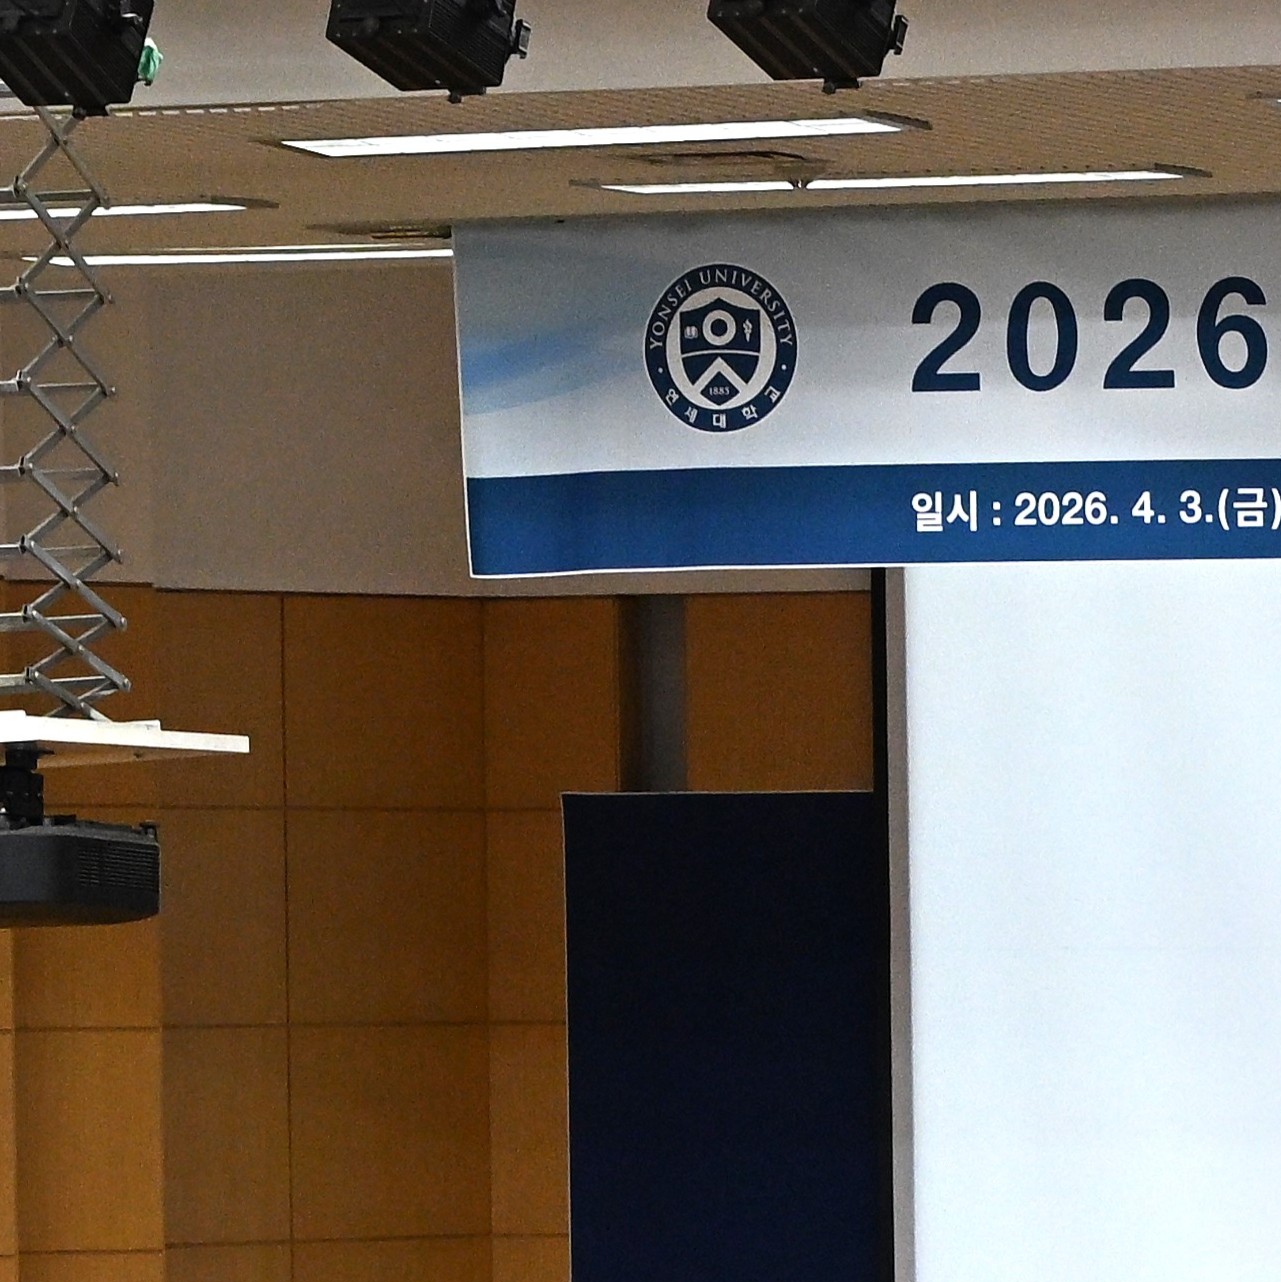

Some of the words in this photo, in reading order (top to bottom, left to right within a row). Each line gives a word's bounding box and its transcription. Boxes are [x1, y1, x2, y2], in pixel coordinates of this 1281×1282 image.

[650, 279, 693, 350] YONSEI
[699, 269, 793, 346] UNIVERSITY
[911, 275, 1268, 393] 2026
[665, 386, 780, 429] 연세대학교
[911, 490, 978, 533] 일시
[1014, 491, 1119, 526] 2026.
[1131, 490, 1166, 524] 4.
